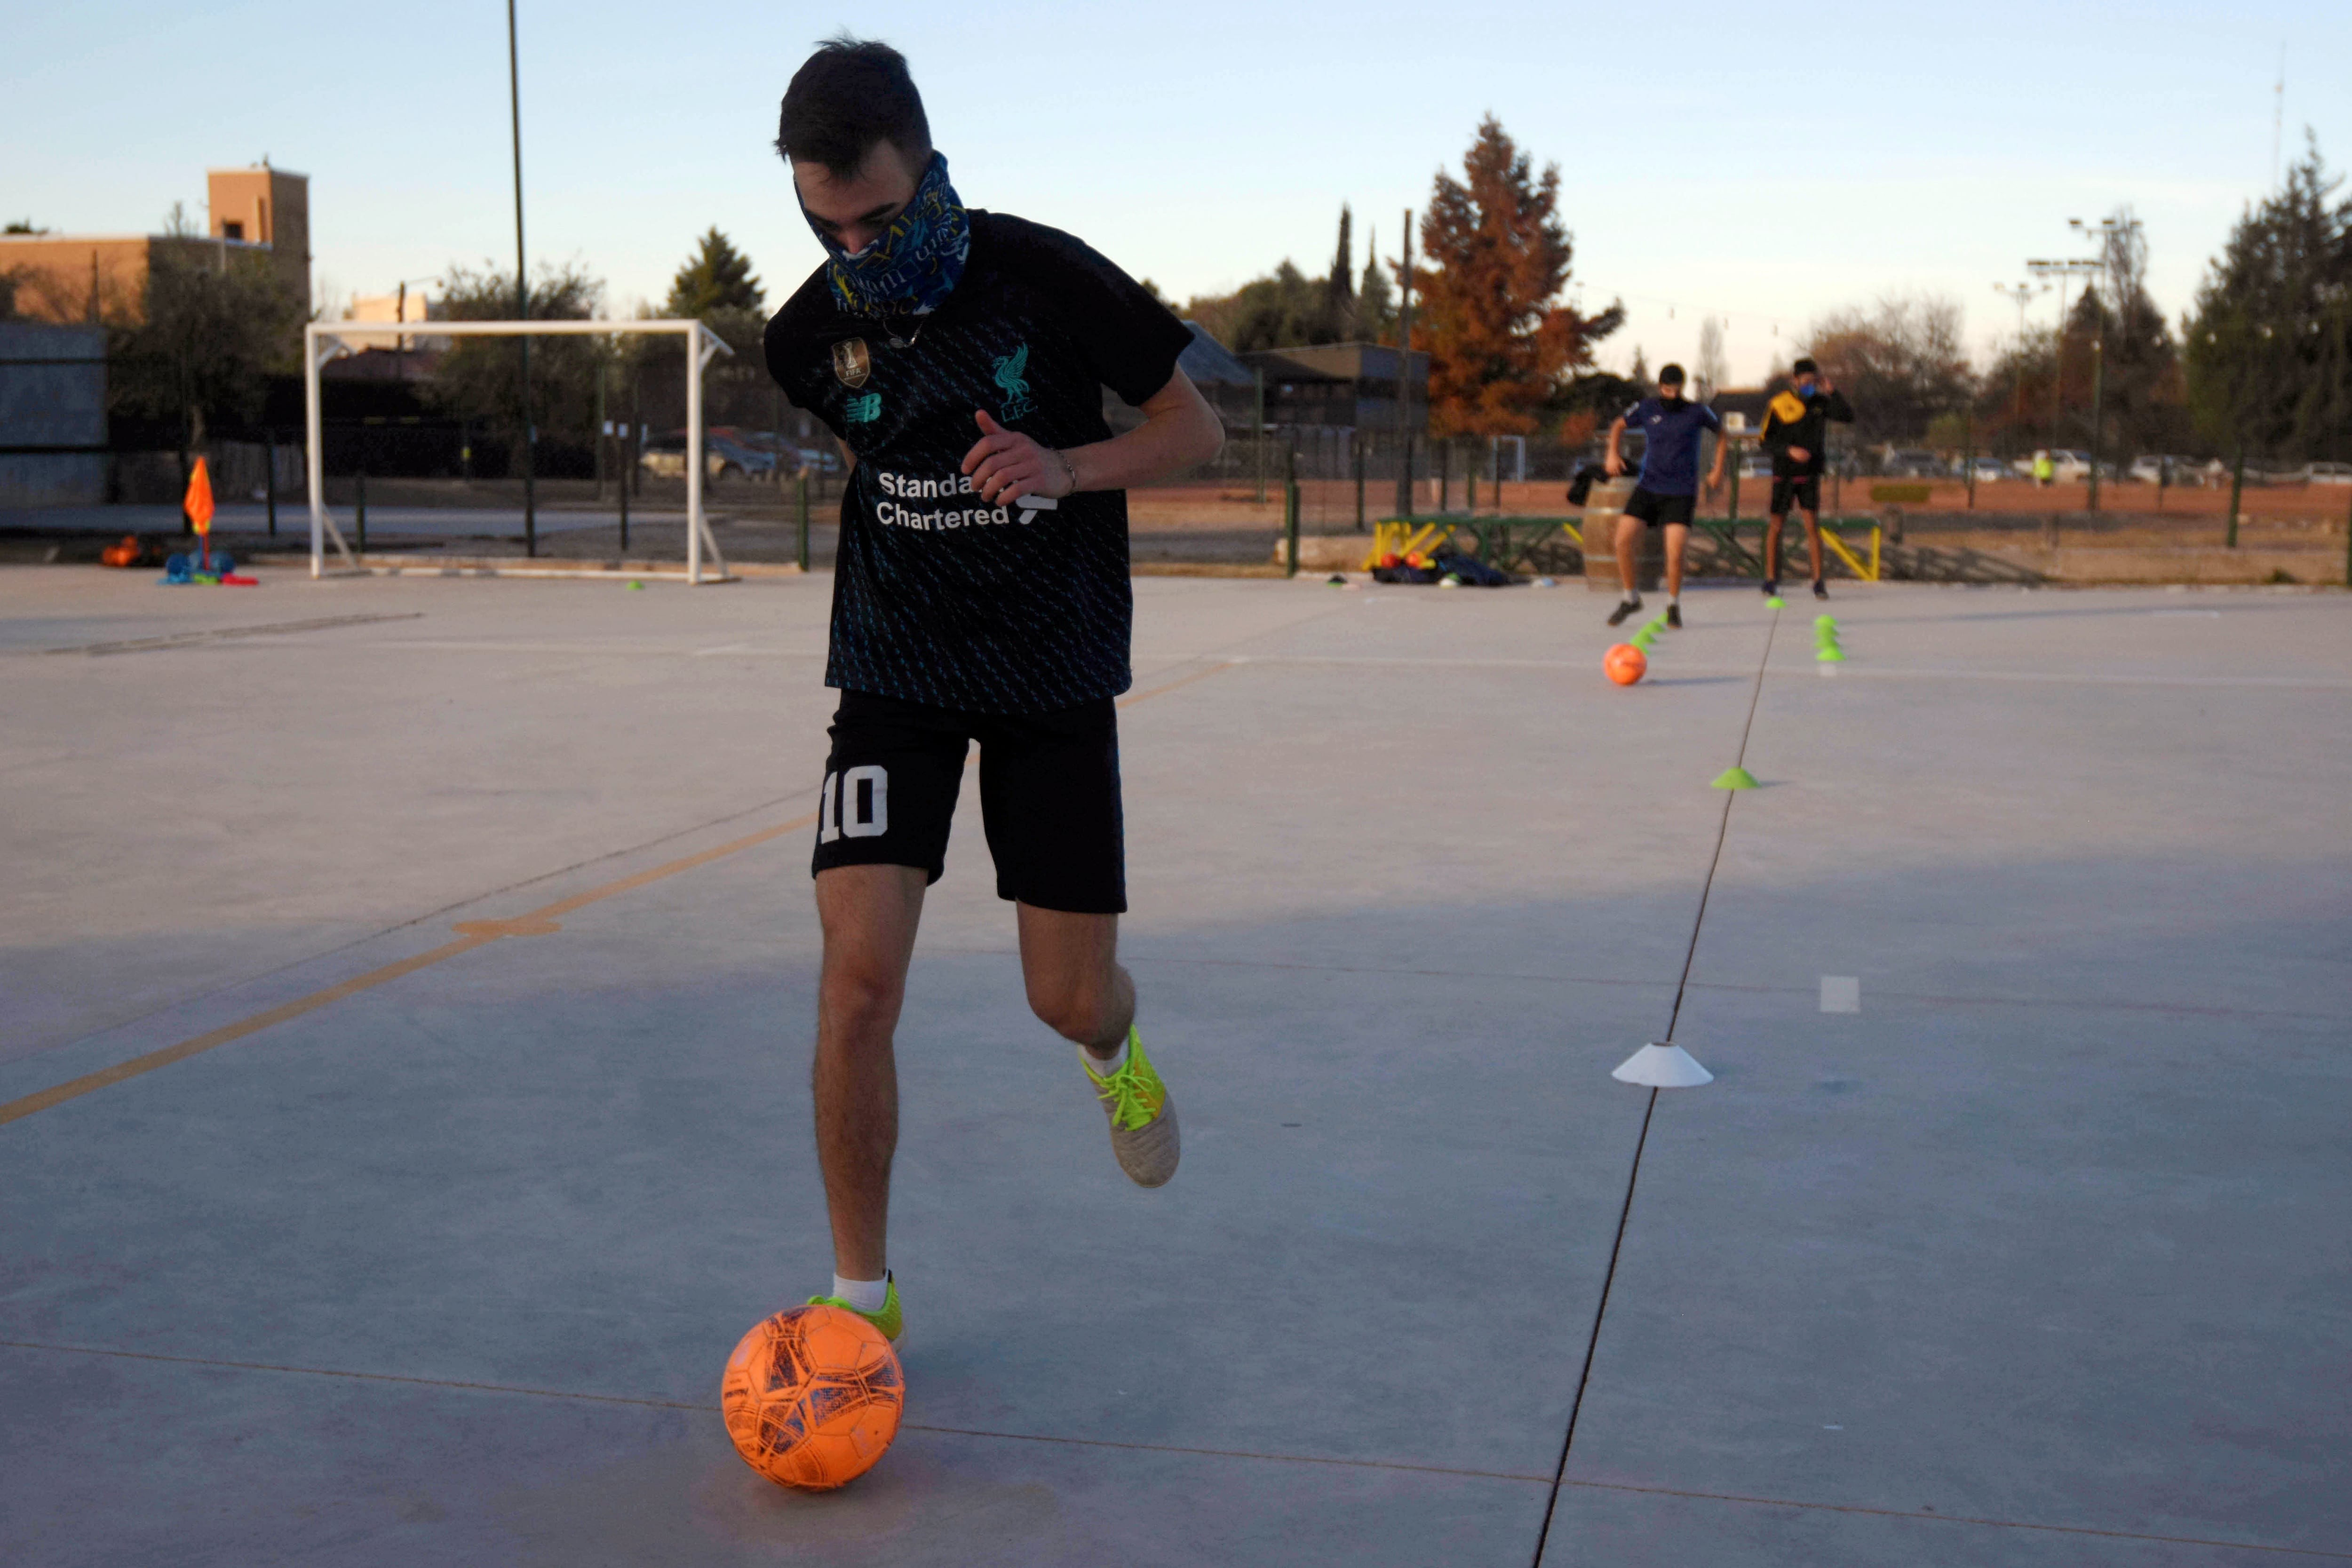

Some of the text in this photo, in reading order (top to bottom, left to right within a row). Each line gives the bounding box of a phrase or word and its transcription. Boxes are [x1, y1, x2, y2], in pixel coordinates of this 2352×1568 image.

[845, 368, 861, 376] FIFA
[879, 472, 1004, 498] Standa
[876, 501, 1009, 531] Chartered
[821, 765, 888, 844] 10
